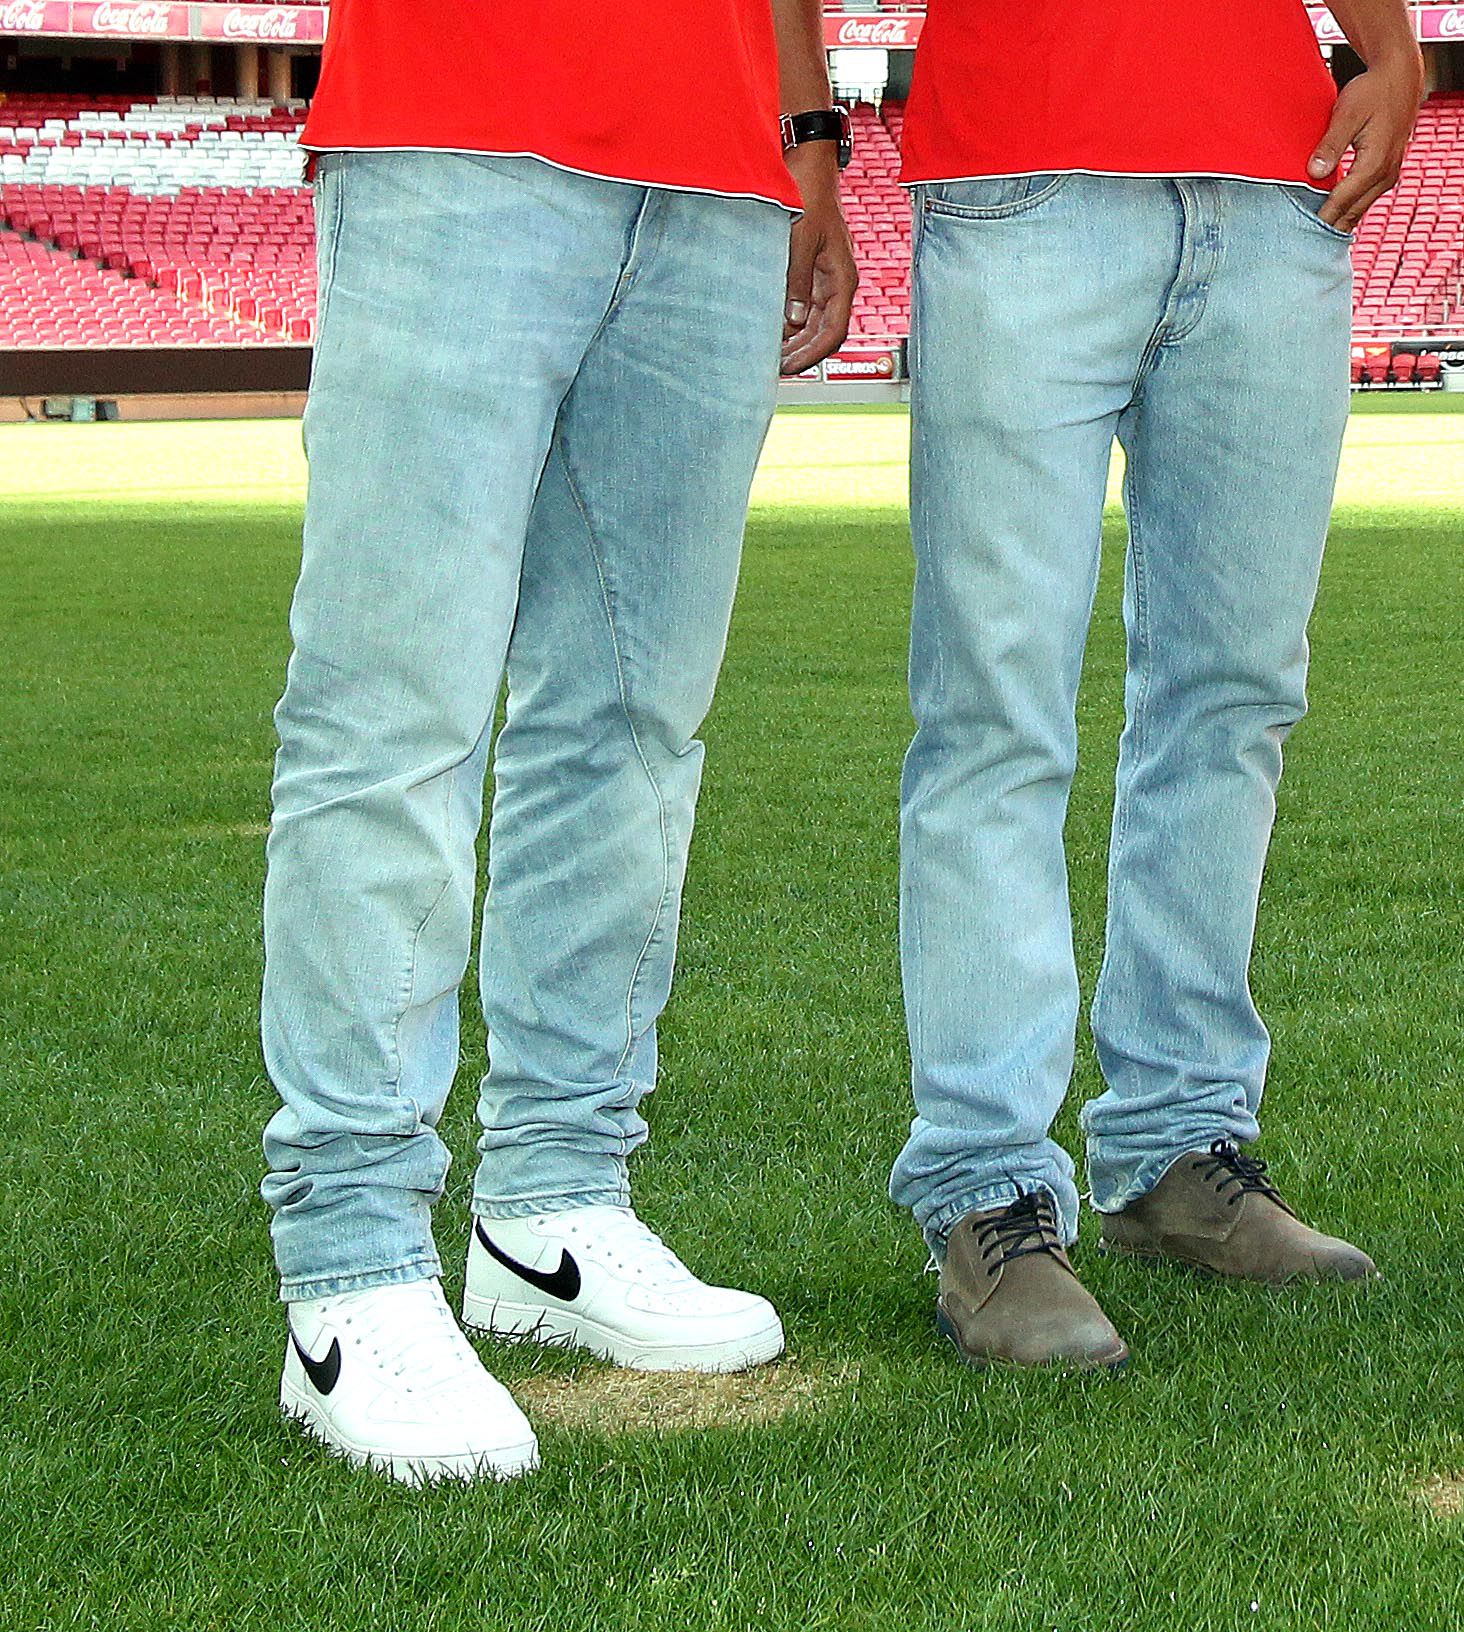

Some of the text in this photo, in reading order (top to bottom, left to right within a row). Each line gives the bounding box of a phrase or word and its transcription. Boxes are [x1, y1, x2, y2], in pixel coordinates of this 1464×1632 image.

[92, 2, 171, 33] Coca-Cola
[223, 7, 298, 38] Coca-Cola
[839, 19, 909, 43] Coca-Cola
[826, 362, 876, 374] SEGUROS
